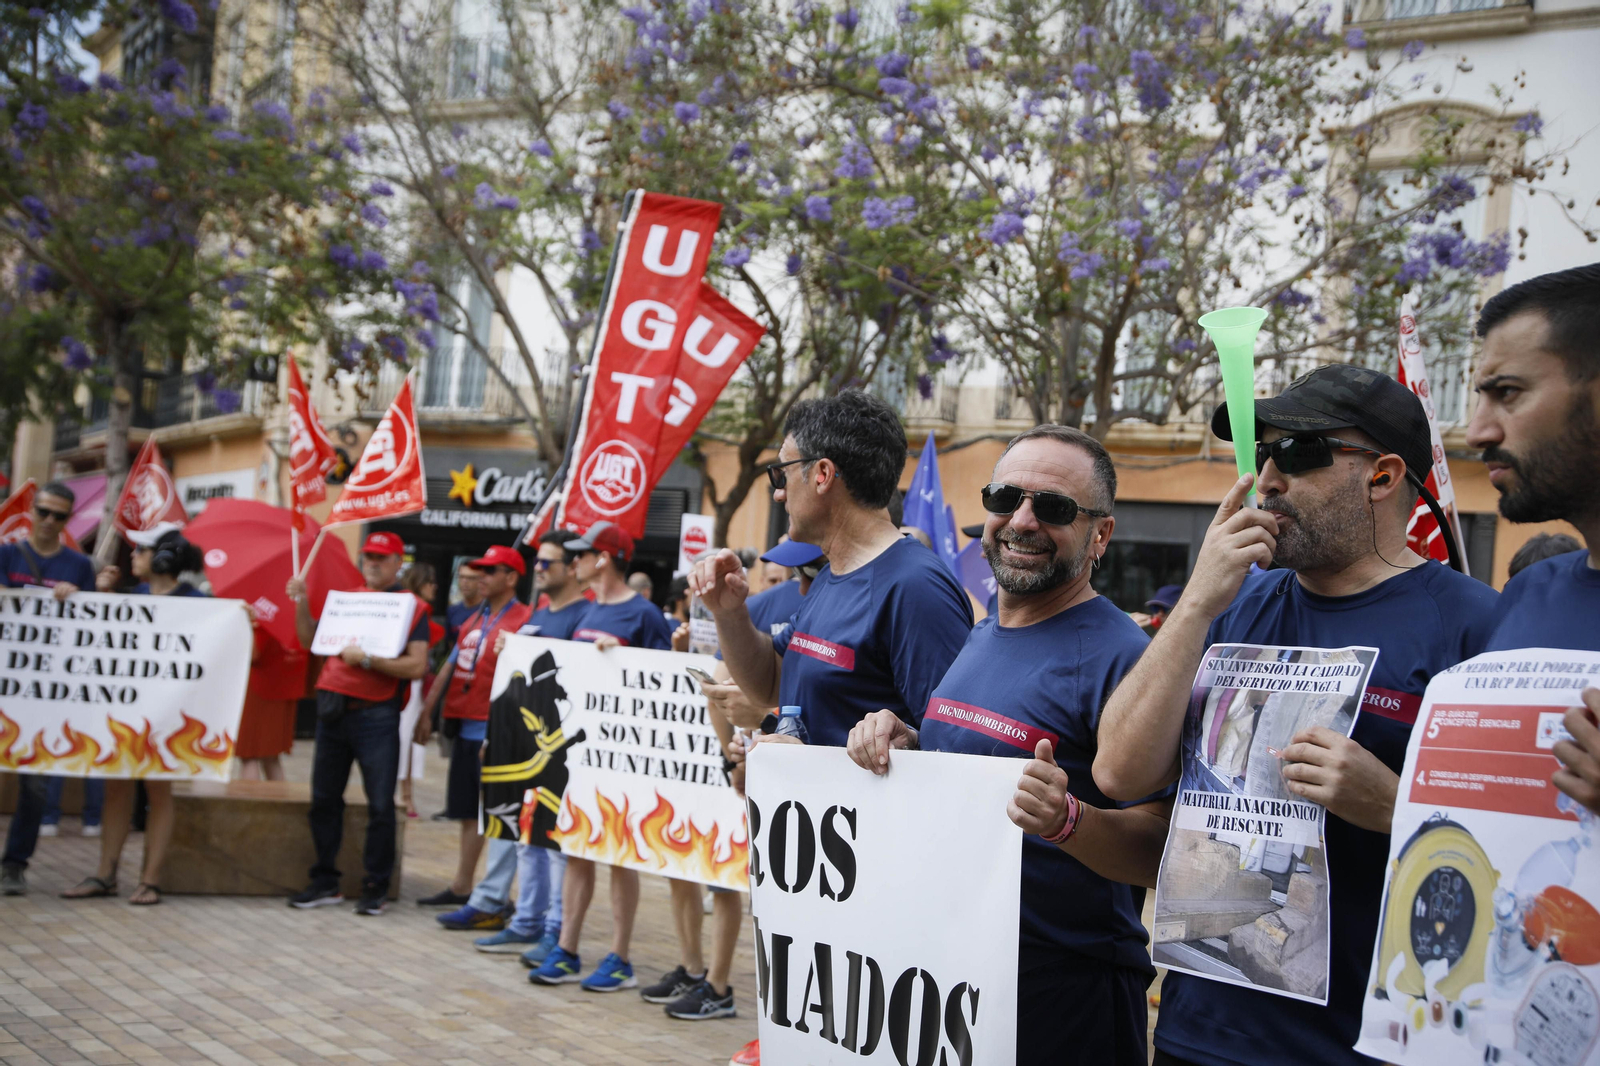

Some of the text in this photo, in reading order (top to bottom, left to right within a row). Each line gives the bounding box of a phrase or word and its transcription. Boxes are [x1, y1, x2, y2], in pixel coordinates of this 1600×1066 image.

[611, 223, 701, 425] UGT
[1269, 412, 1331, 425] BROWNING
[592, 451, 637, 488] UGT
[474, 467, 548, 506] Carl's
[420, 509, 531, 531] CALIFORNIA BU
[0, 594, 158, 624] VERSIÓN
[74, 627, 139, 650] DAR
[152, 633, 194, 653] UN
[7, 649, 205, 682] DE CALIDAD
[1205, 658, 1362, 678] SIN INVERSIÓN LA CALIDAD
[1506, 661, 1540, 673] PARA
[1540, 661, 1587, 674] PODER
[0, 677, 139, 705] DADANO
[621, 668, 705, 696] LAS IN
[1214, 675, 1342, 693] DEL SERVICIO MENGUA
[1464, 677, 1590, 689] UNA RCP DE CALIDAD
[585, 692, 626, 716] DEL
[1363, 692, 1401, 711] EROS
[936, 703, 1028, 742] DIGNIDAD BOMBEROS
[1427, 717, 1440, 739] 5
[598, 722, 643, 746] SON
[649, 729, 676, 751] LA
[580, 747, 732, 788] AYUNTAMIEN
[1181, 791, 1318, 822] MATERIAL ANACRÓNICO
[1206, 814, 1284, 838] DE RESCATE
